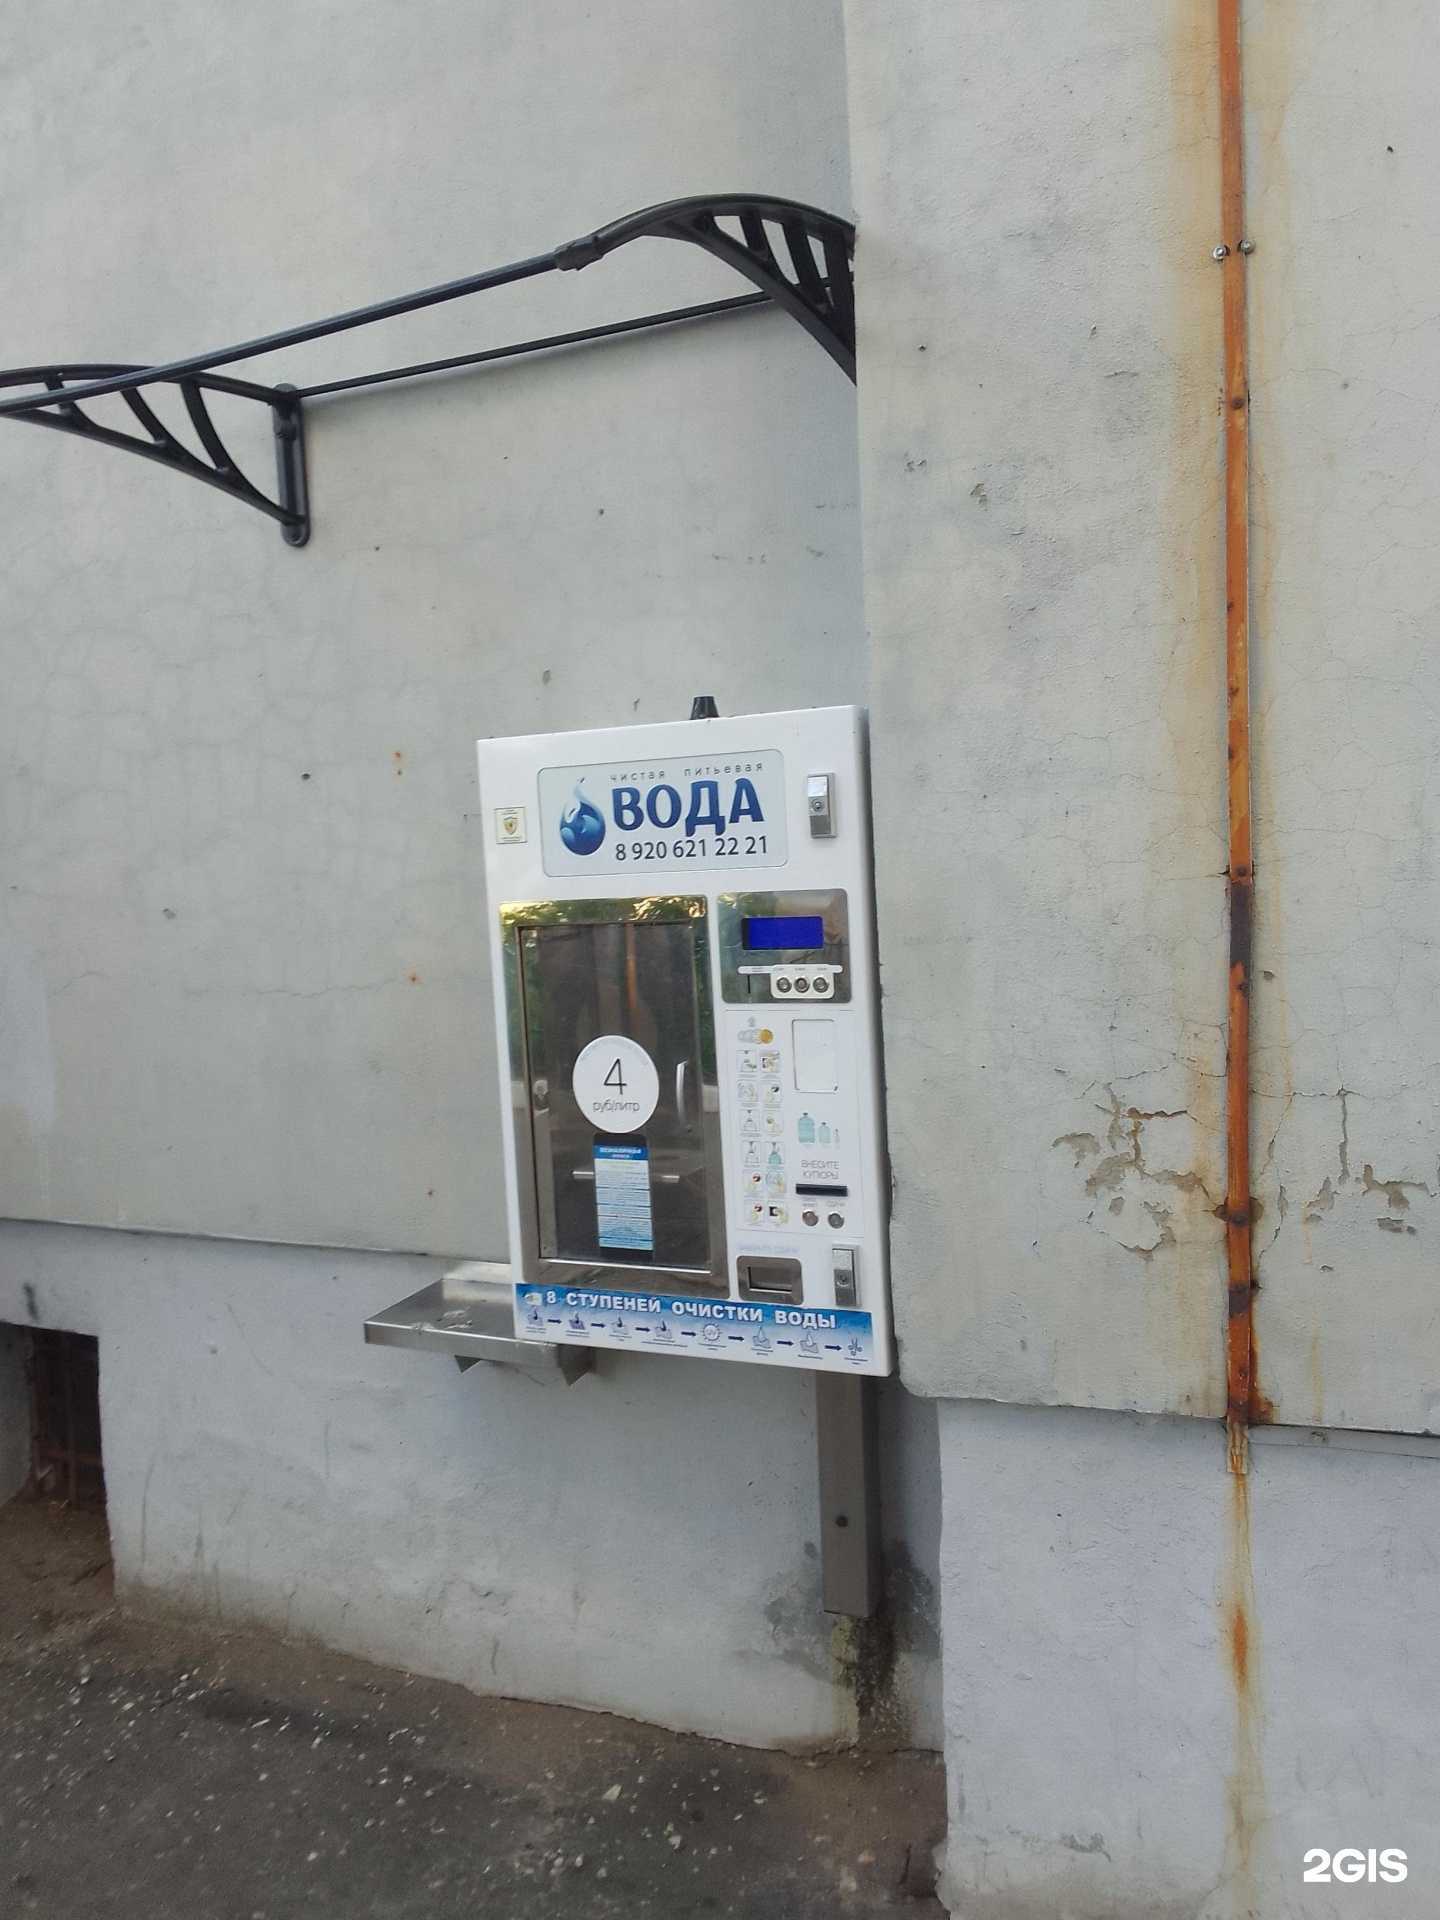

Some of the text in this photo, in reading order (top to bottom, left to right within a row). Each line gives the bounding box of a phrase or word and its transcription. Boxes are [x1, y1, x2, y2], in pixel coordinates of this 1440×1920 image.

[610, 762, 764, 781] чистая питьевая
[612, 777, 765, 837] ВОДА
[615, 835, 768, 861] 8 920 621 22 21
[603, 1058, 628, 1096] 4
[546, 1290, 837, 1330] 8 СТУПЕНЕЙ ОЧИСТКИ ВОДЫ
